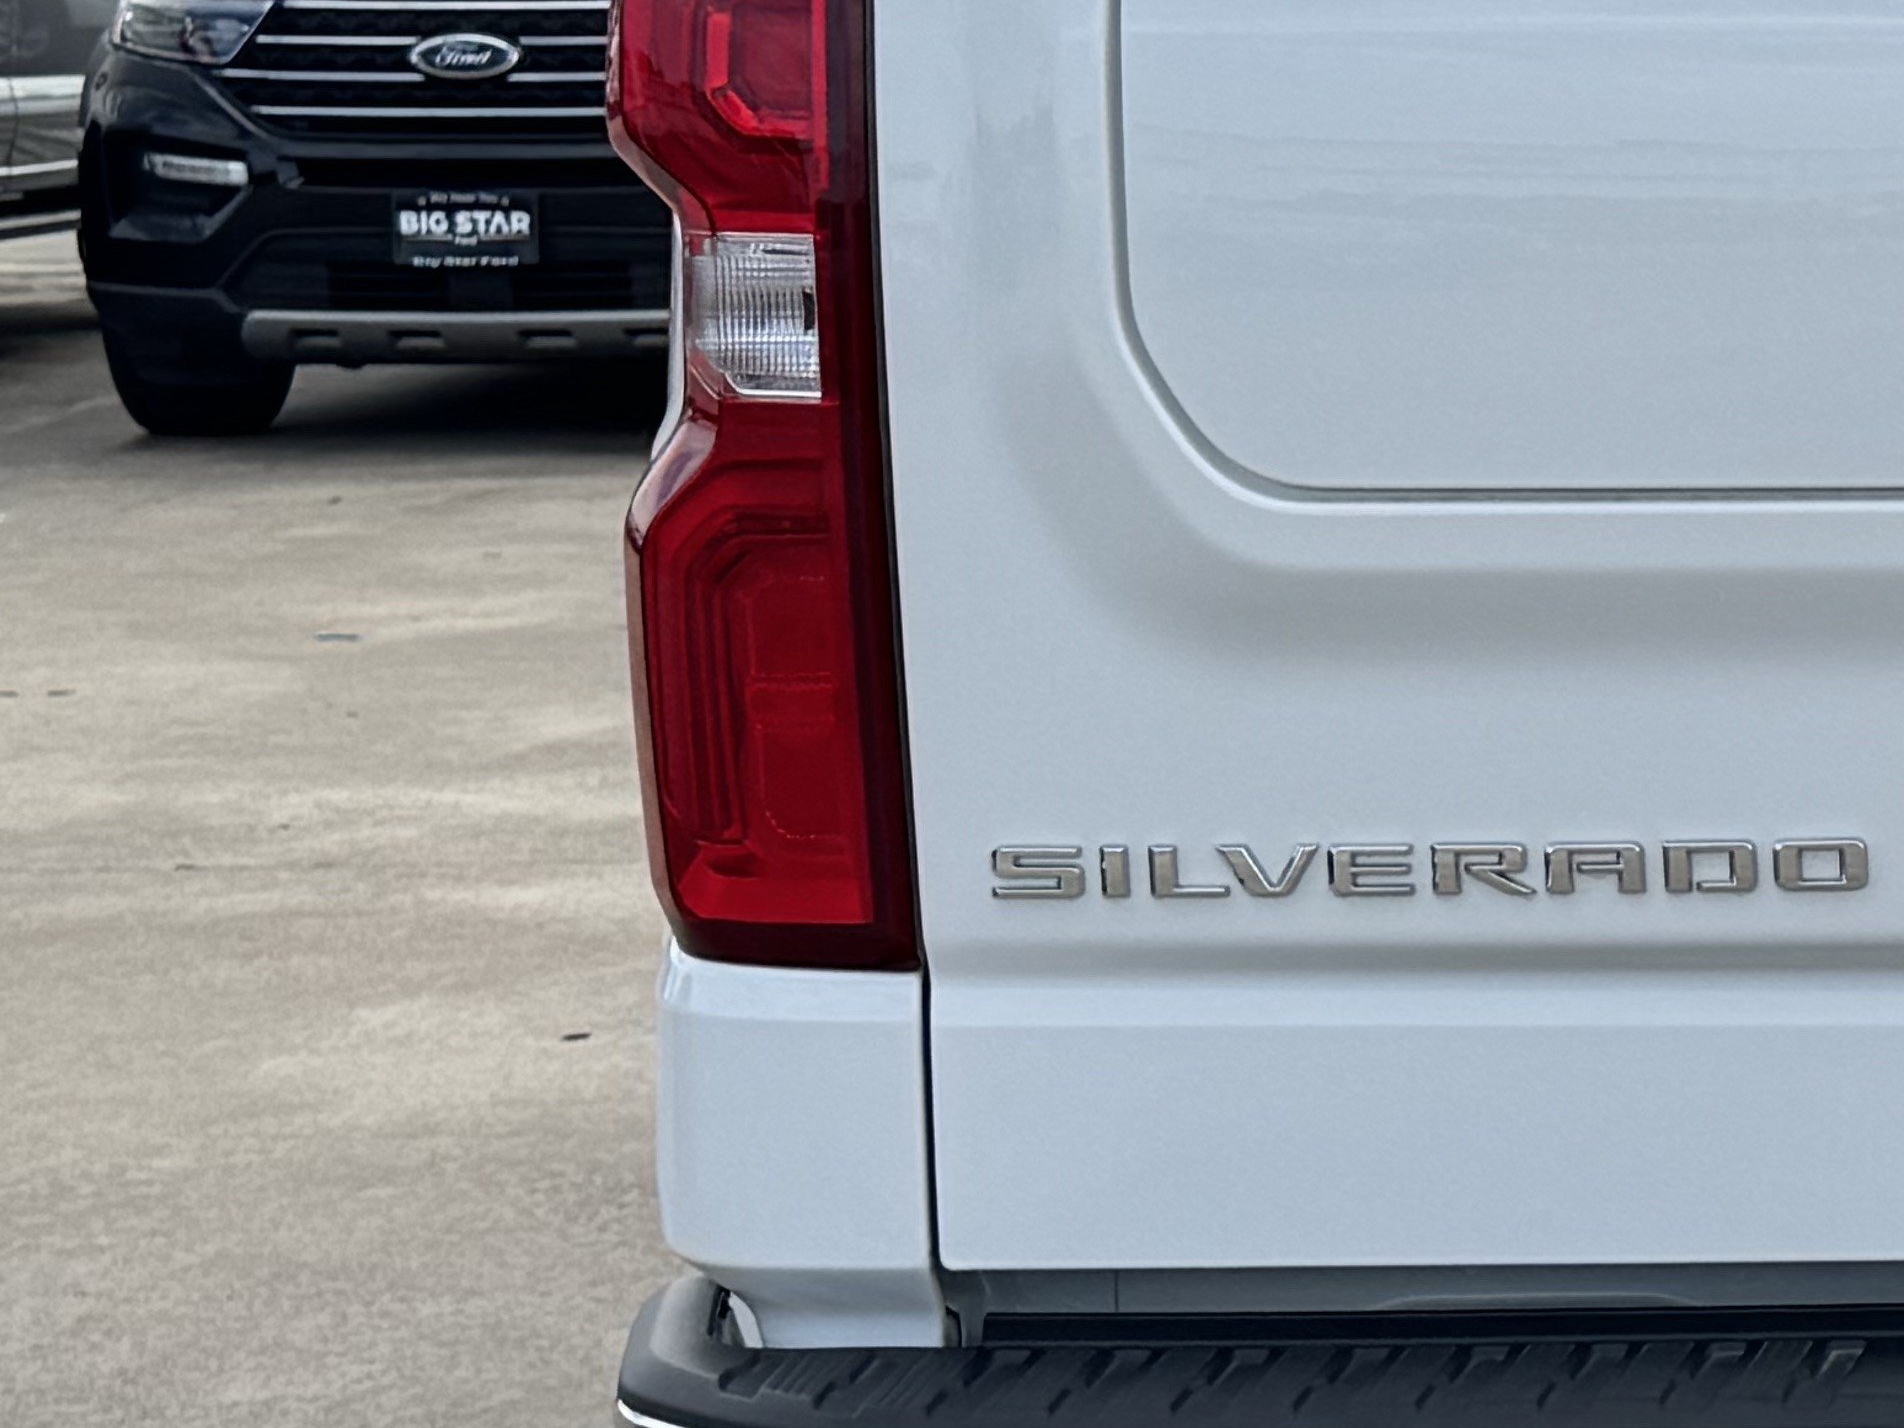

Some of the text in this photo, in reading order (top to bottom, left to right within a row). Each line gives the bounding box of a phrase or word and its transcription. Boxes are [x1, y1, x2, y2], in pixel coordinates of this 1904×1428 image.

[399, 210, 530, 235] BIG STAR
[990, 836, 1869, 899] SILVERADO
